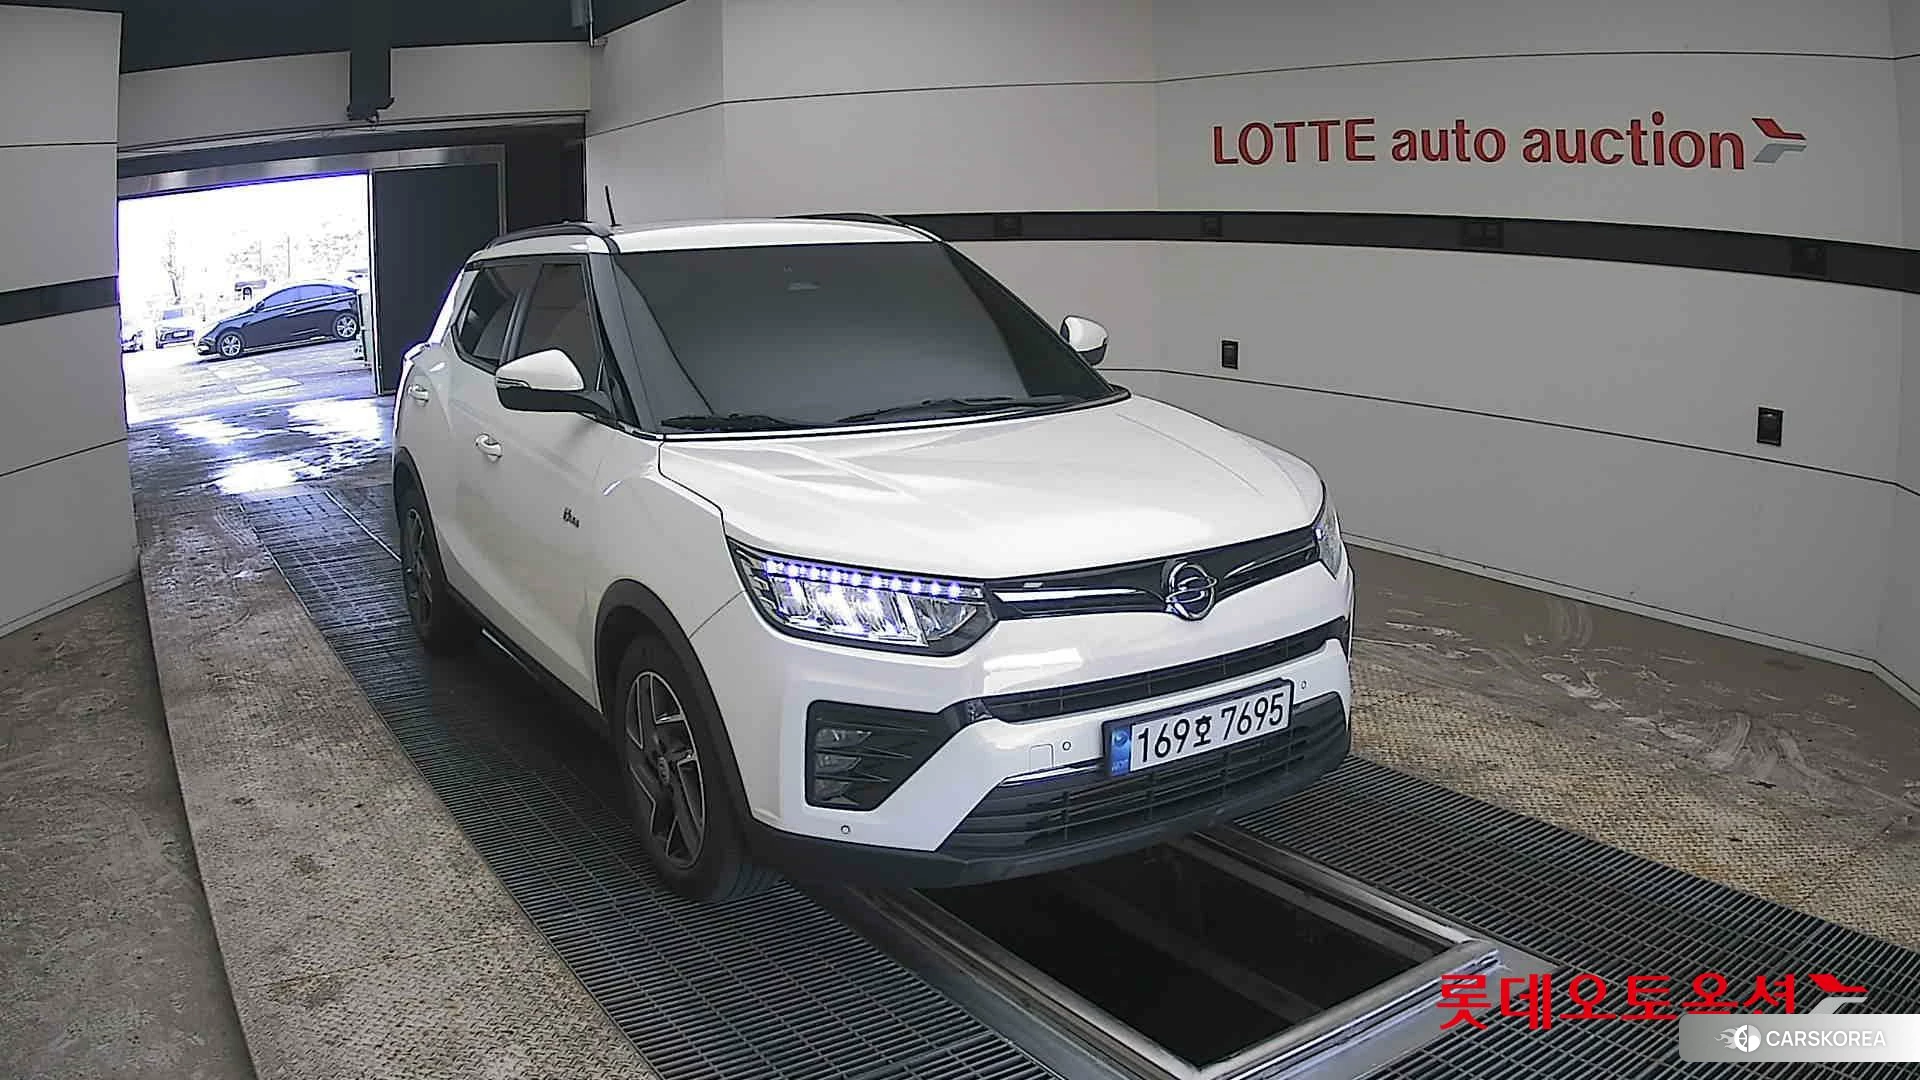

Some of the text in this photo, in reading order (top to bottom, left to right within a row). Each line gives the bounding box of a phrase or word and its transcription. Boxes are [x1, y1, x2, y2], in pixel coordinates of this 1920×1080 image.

[1212, 111, 1746, 170] LOTTE auto auction
[1137, 692, 1284, 763] 169호 7695
